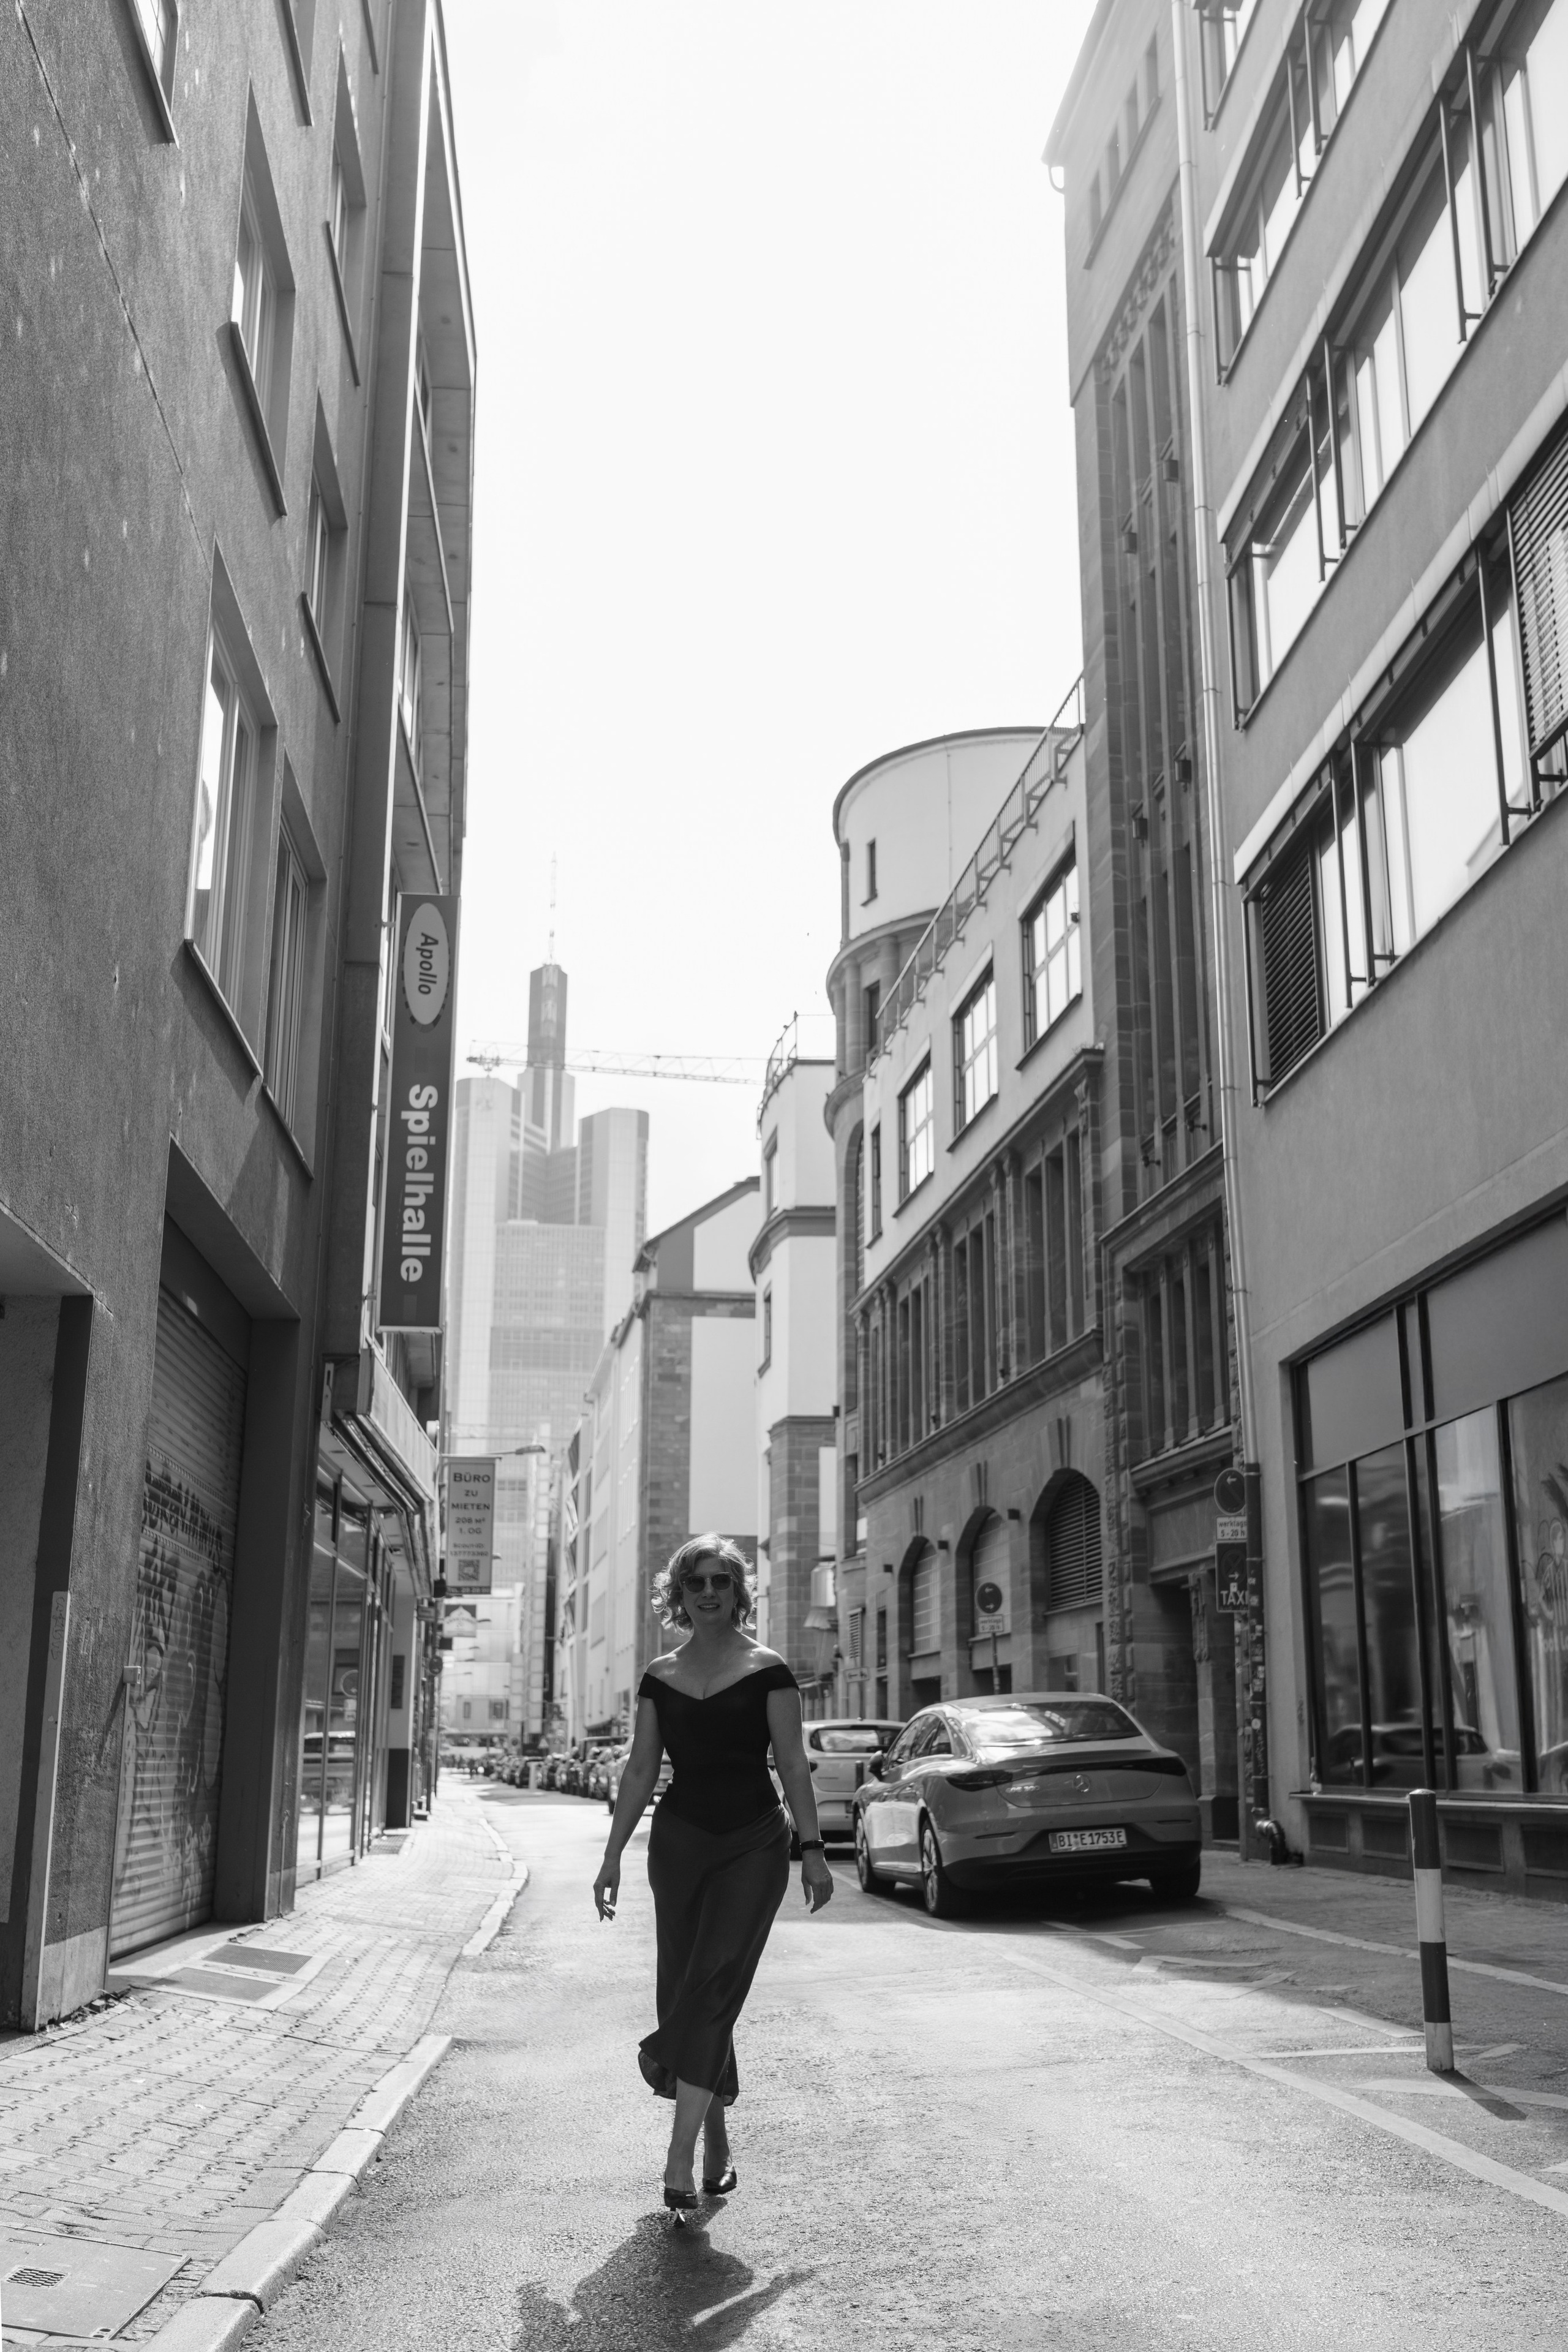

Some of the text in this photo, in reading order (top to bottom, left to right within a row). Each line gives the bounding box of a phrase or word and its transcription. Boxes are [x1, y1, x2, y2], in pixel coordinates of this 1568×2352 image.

[417, 932, 437, 996] Apollo
[400, 1084, 439, 1283] Spielhalle
[454, 1472, 491, 1482] BÜRO
[1220, 1591, 1248, 1605] TAXI
[1059, 1835, 1072, 1847] BI
